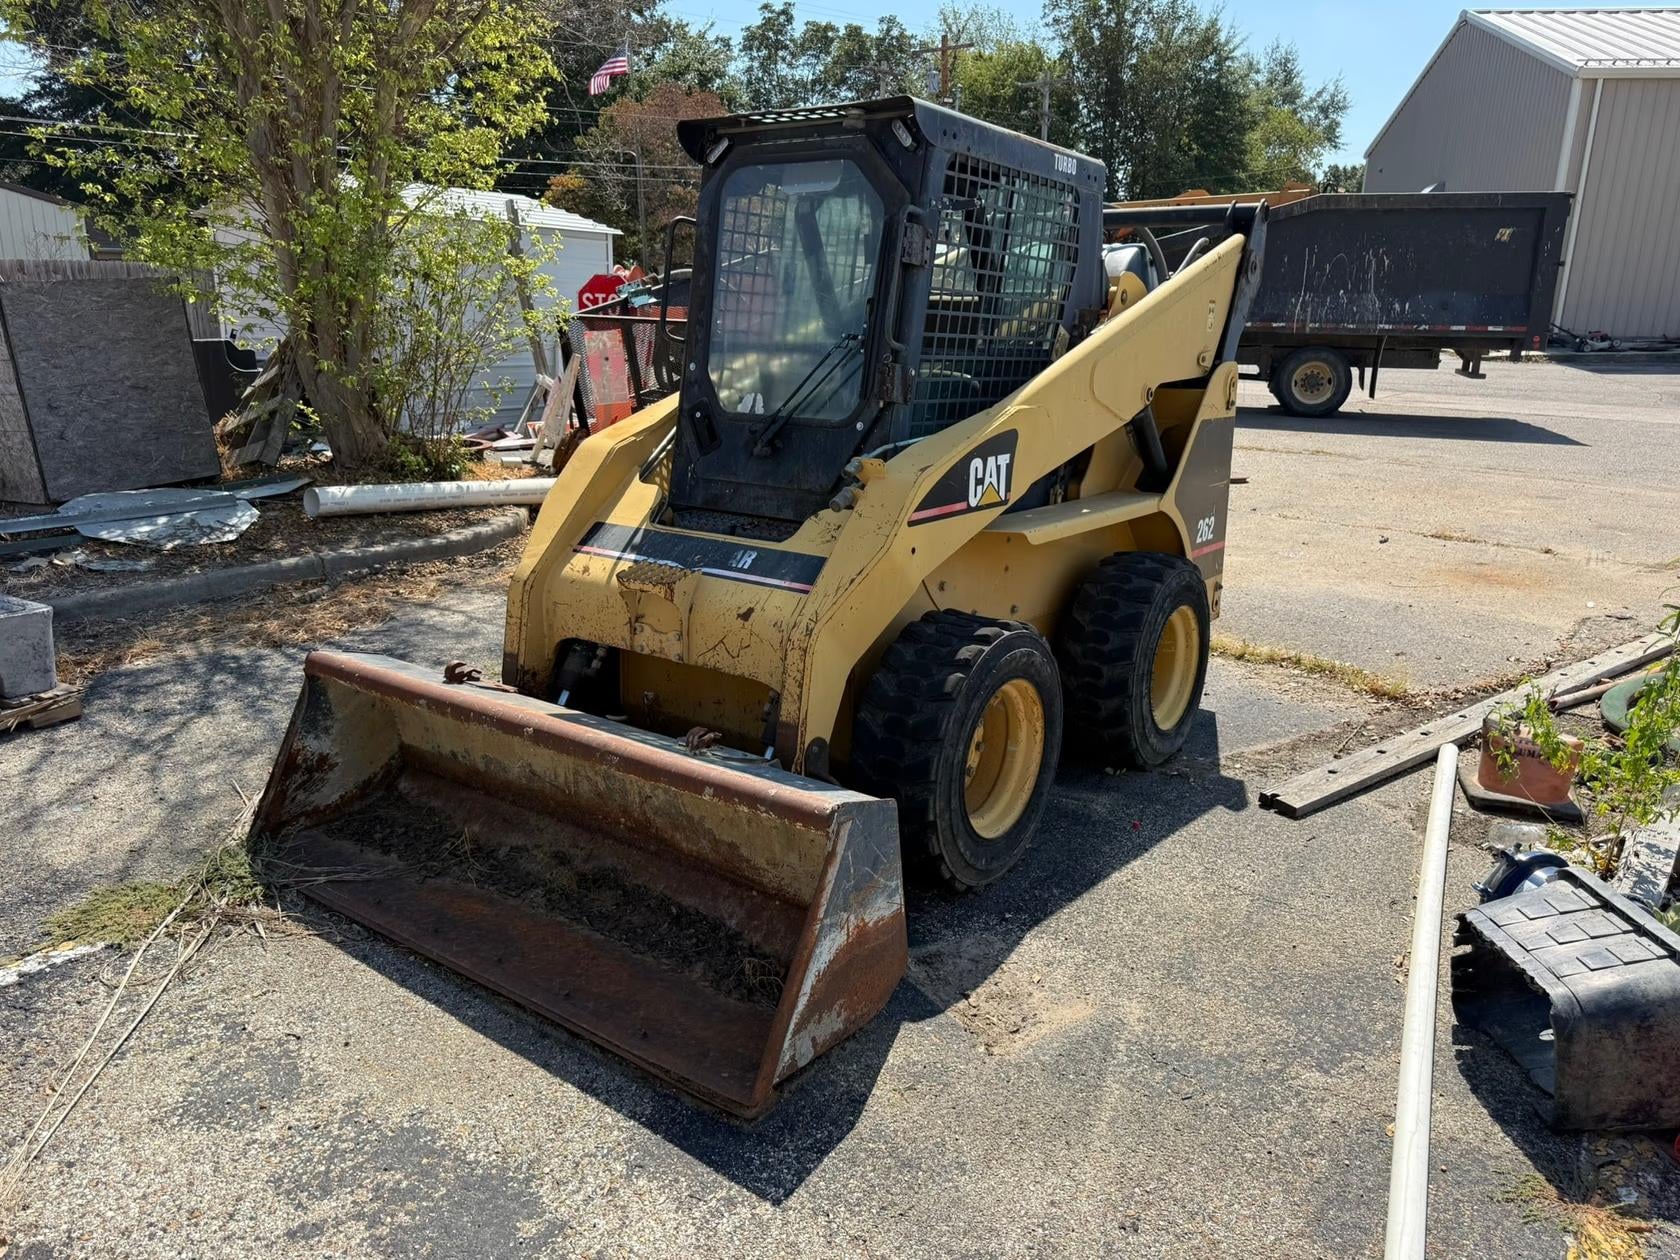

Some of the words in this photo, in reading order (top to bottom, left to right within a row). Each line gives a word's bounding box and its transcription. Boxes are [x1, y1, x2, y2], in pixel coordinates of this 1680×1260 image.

[1054, 153, 1077, 175] TURBO
[582, 292, 621, 316] STO
[968, 453, 1011, 508] CAT
[1196, 516, 1215, 543] 262
